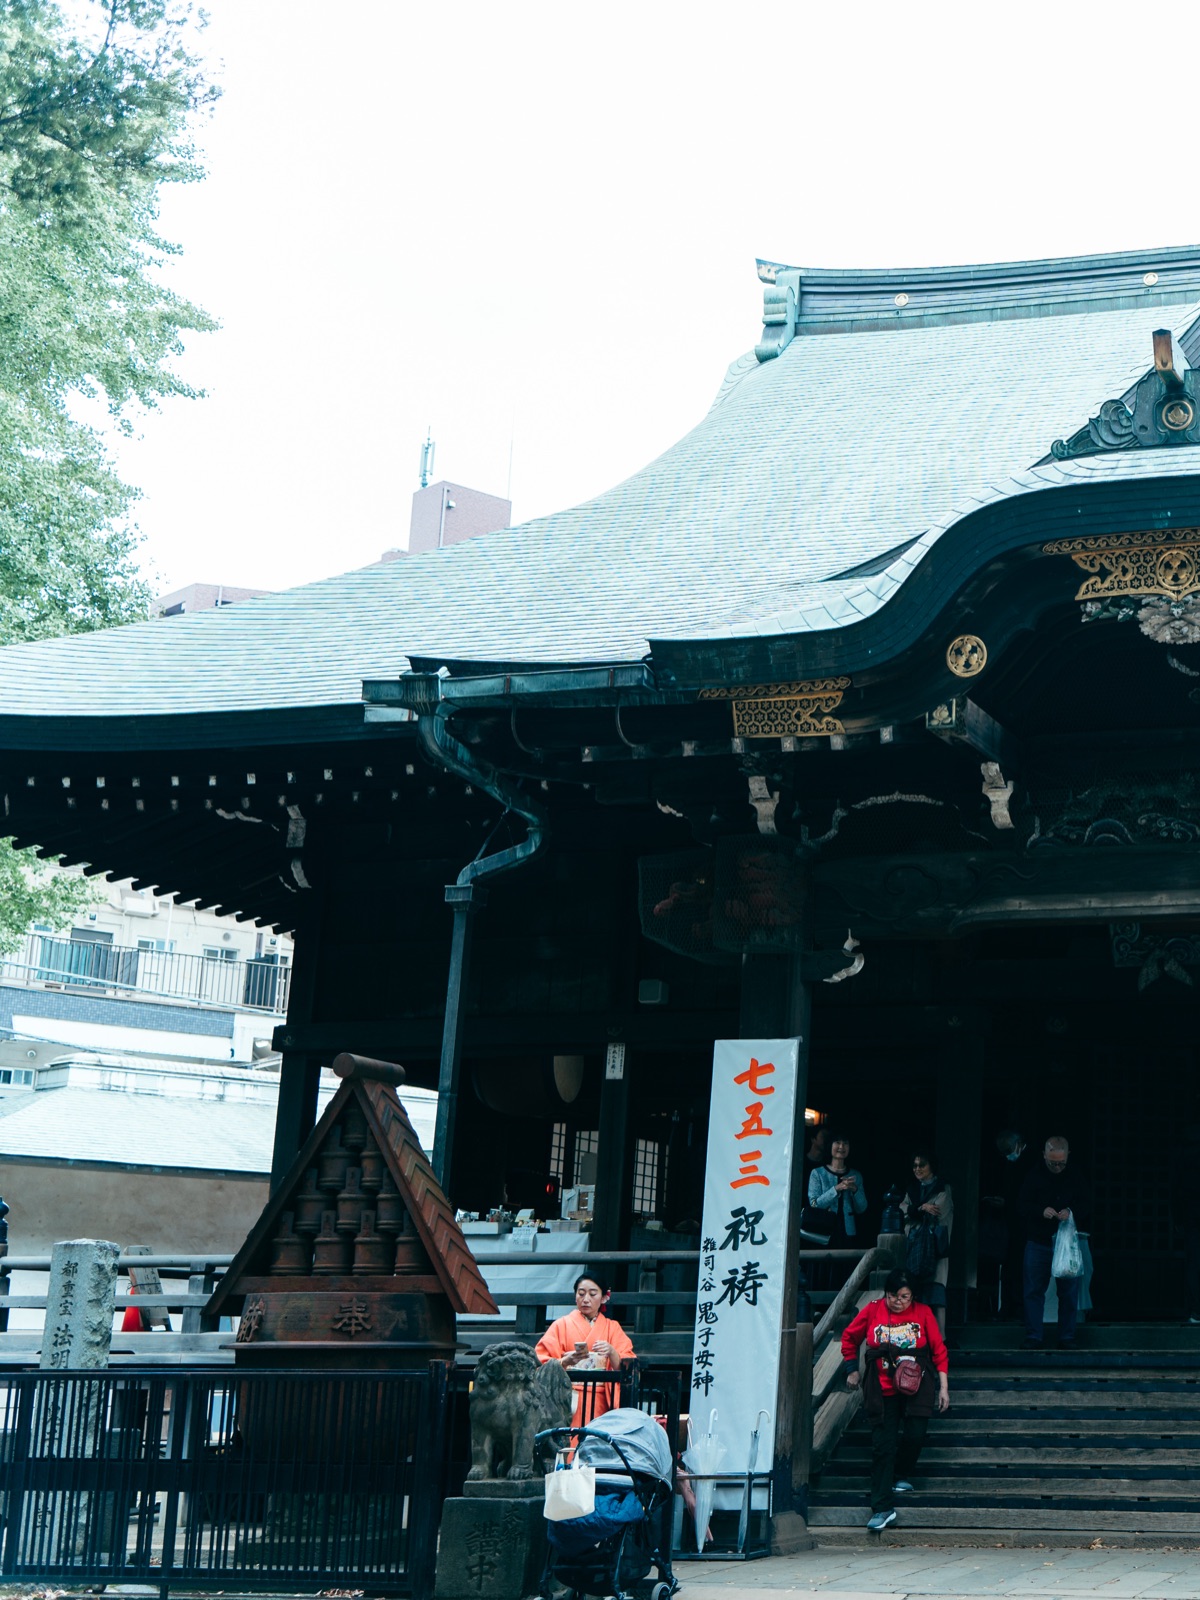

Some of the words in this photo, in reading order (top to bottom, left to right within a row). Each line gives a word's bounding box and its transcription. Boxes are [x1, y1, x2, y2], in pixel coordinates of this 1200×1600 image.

[730, 1057, 776, 1190] 七五三
[332, 1297, 373, 1335] 奉
